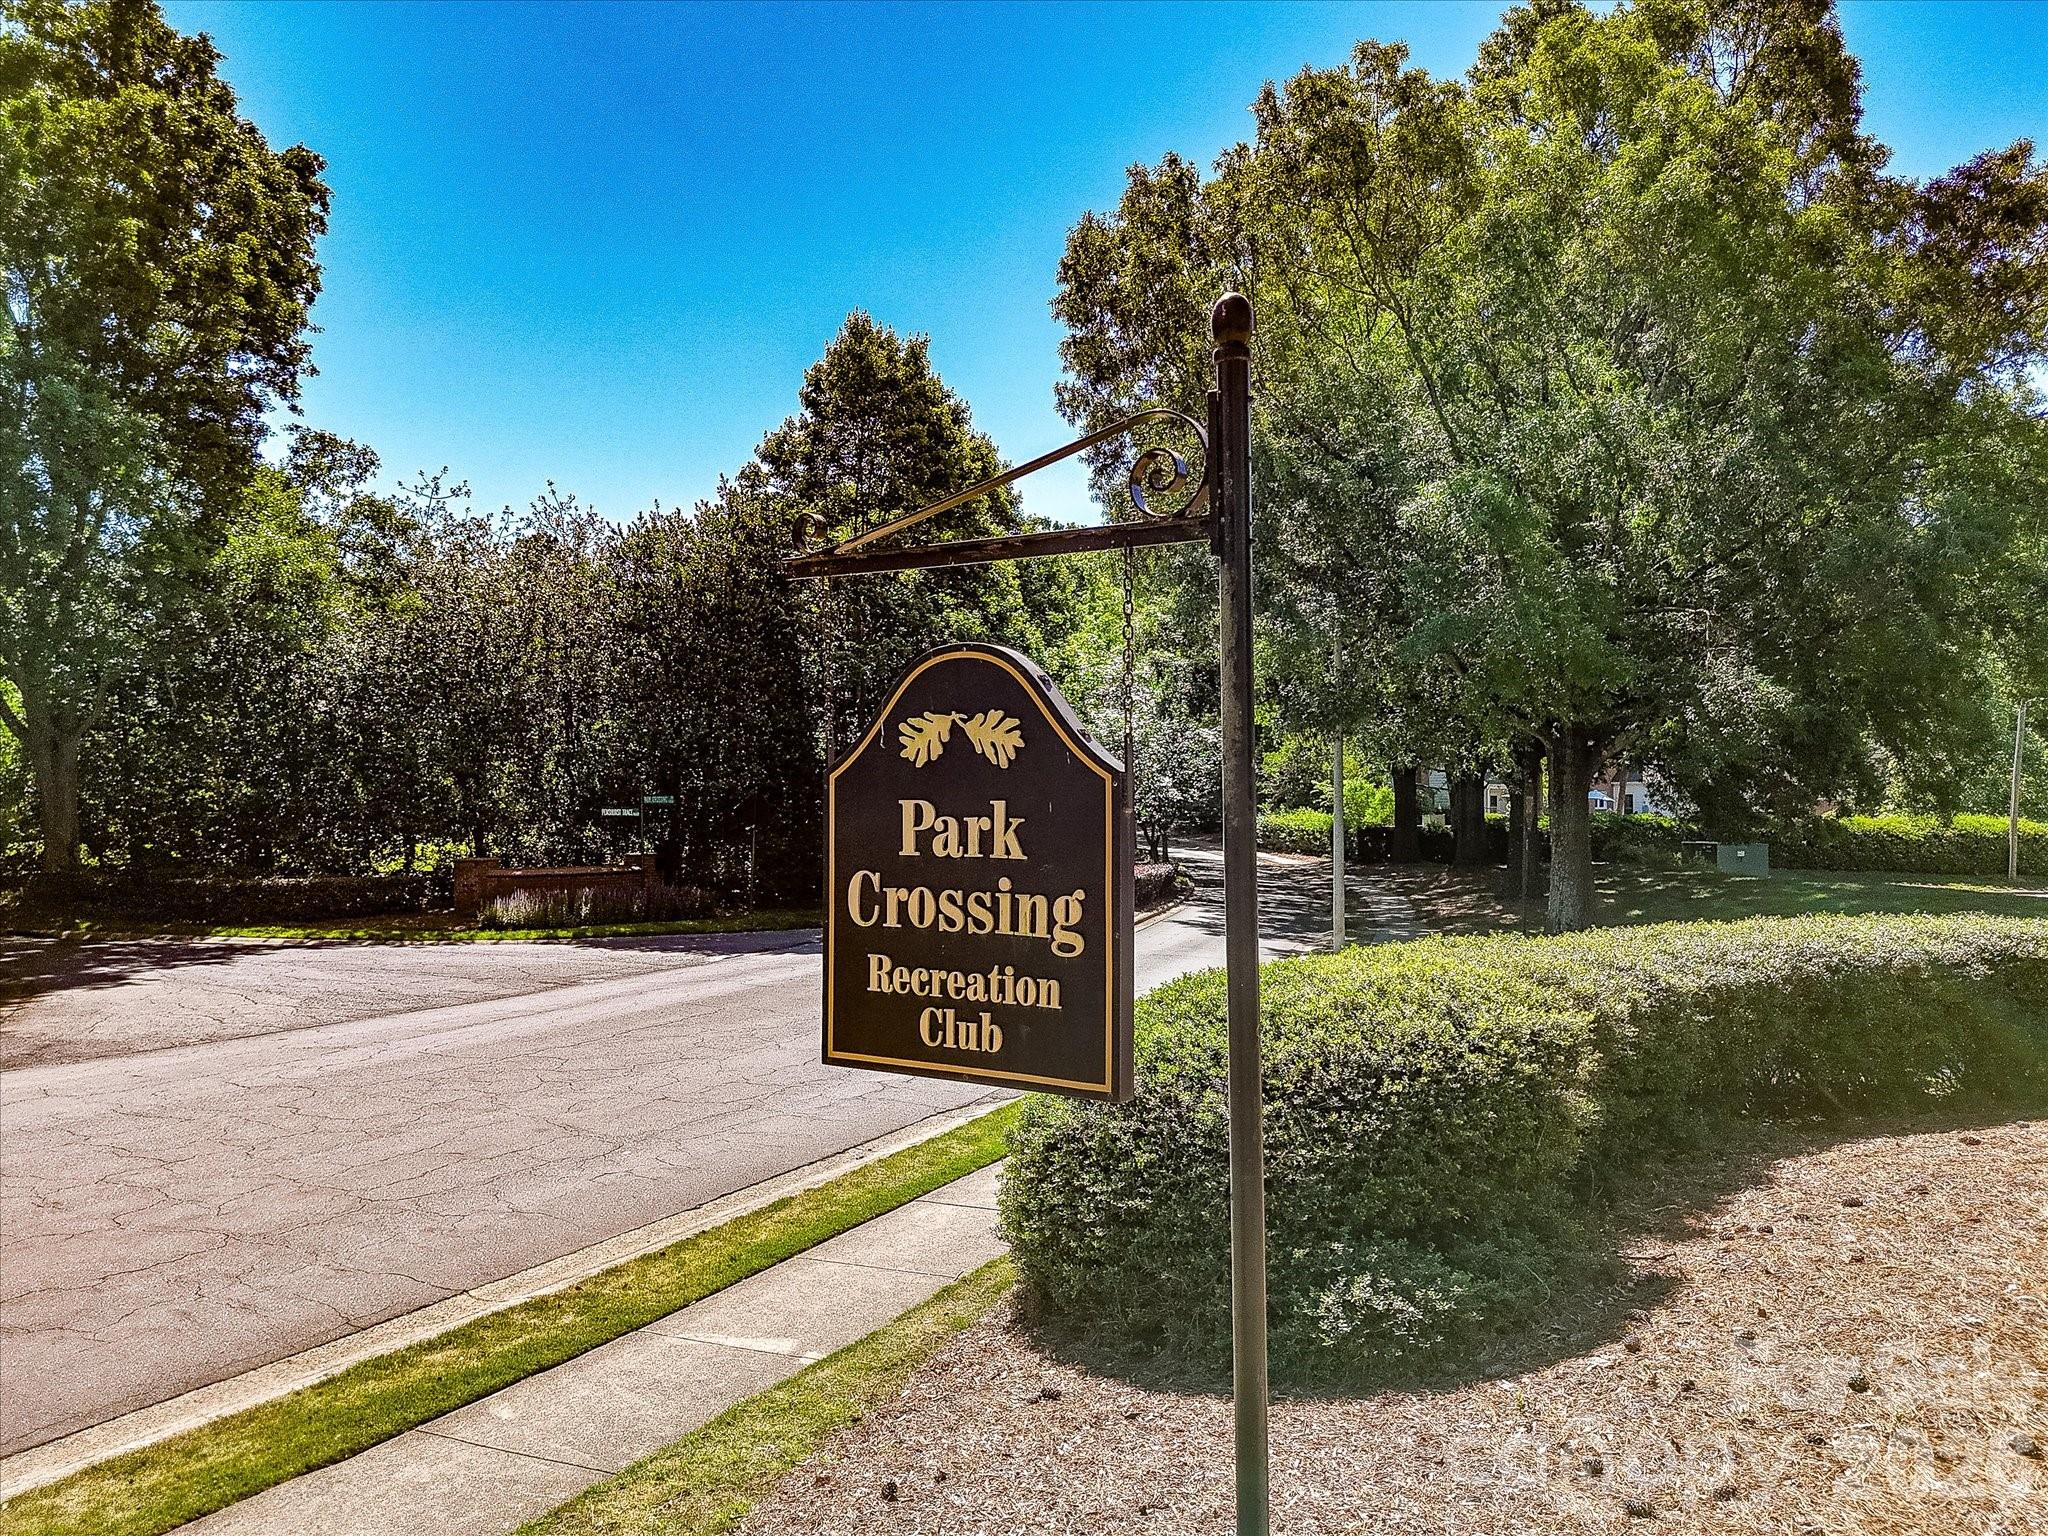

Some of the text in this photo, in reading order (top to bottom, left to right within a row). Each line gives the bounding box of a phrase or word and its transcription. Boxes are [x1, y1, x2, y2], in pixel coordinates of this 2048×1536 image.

[898, 799, 1028, 860] Park
[847, 870, 1086, 958] Crossing
[866, 953, 1062, 1010] Recreation
[919, 1006, 1004, 1053] Club
